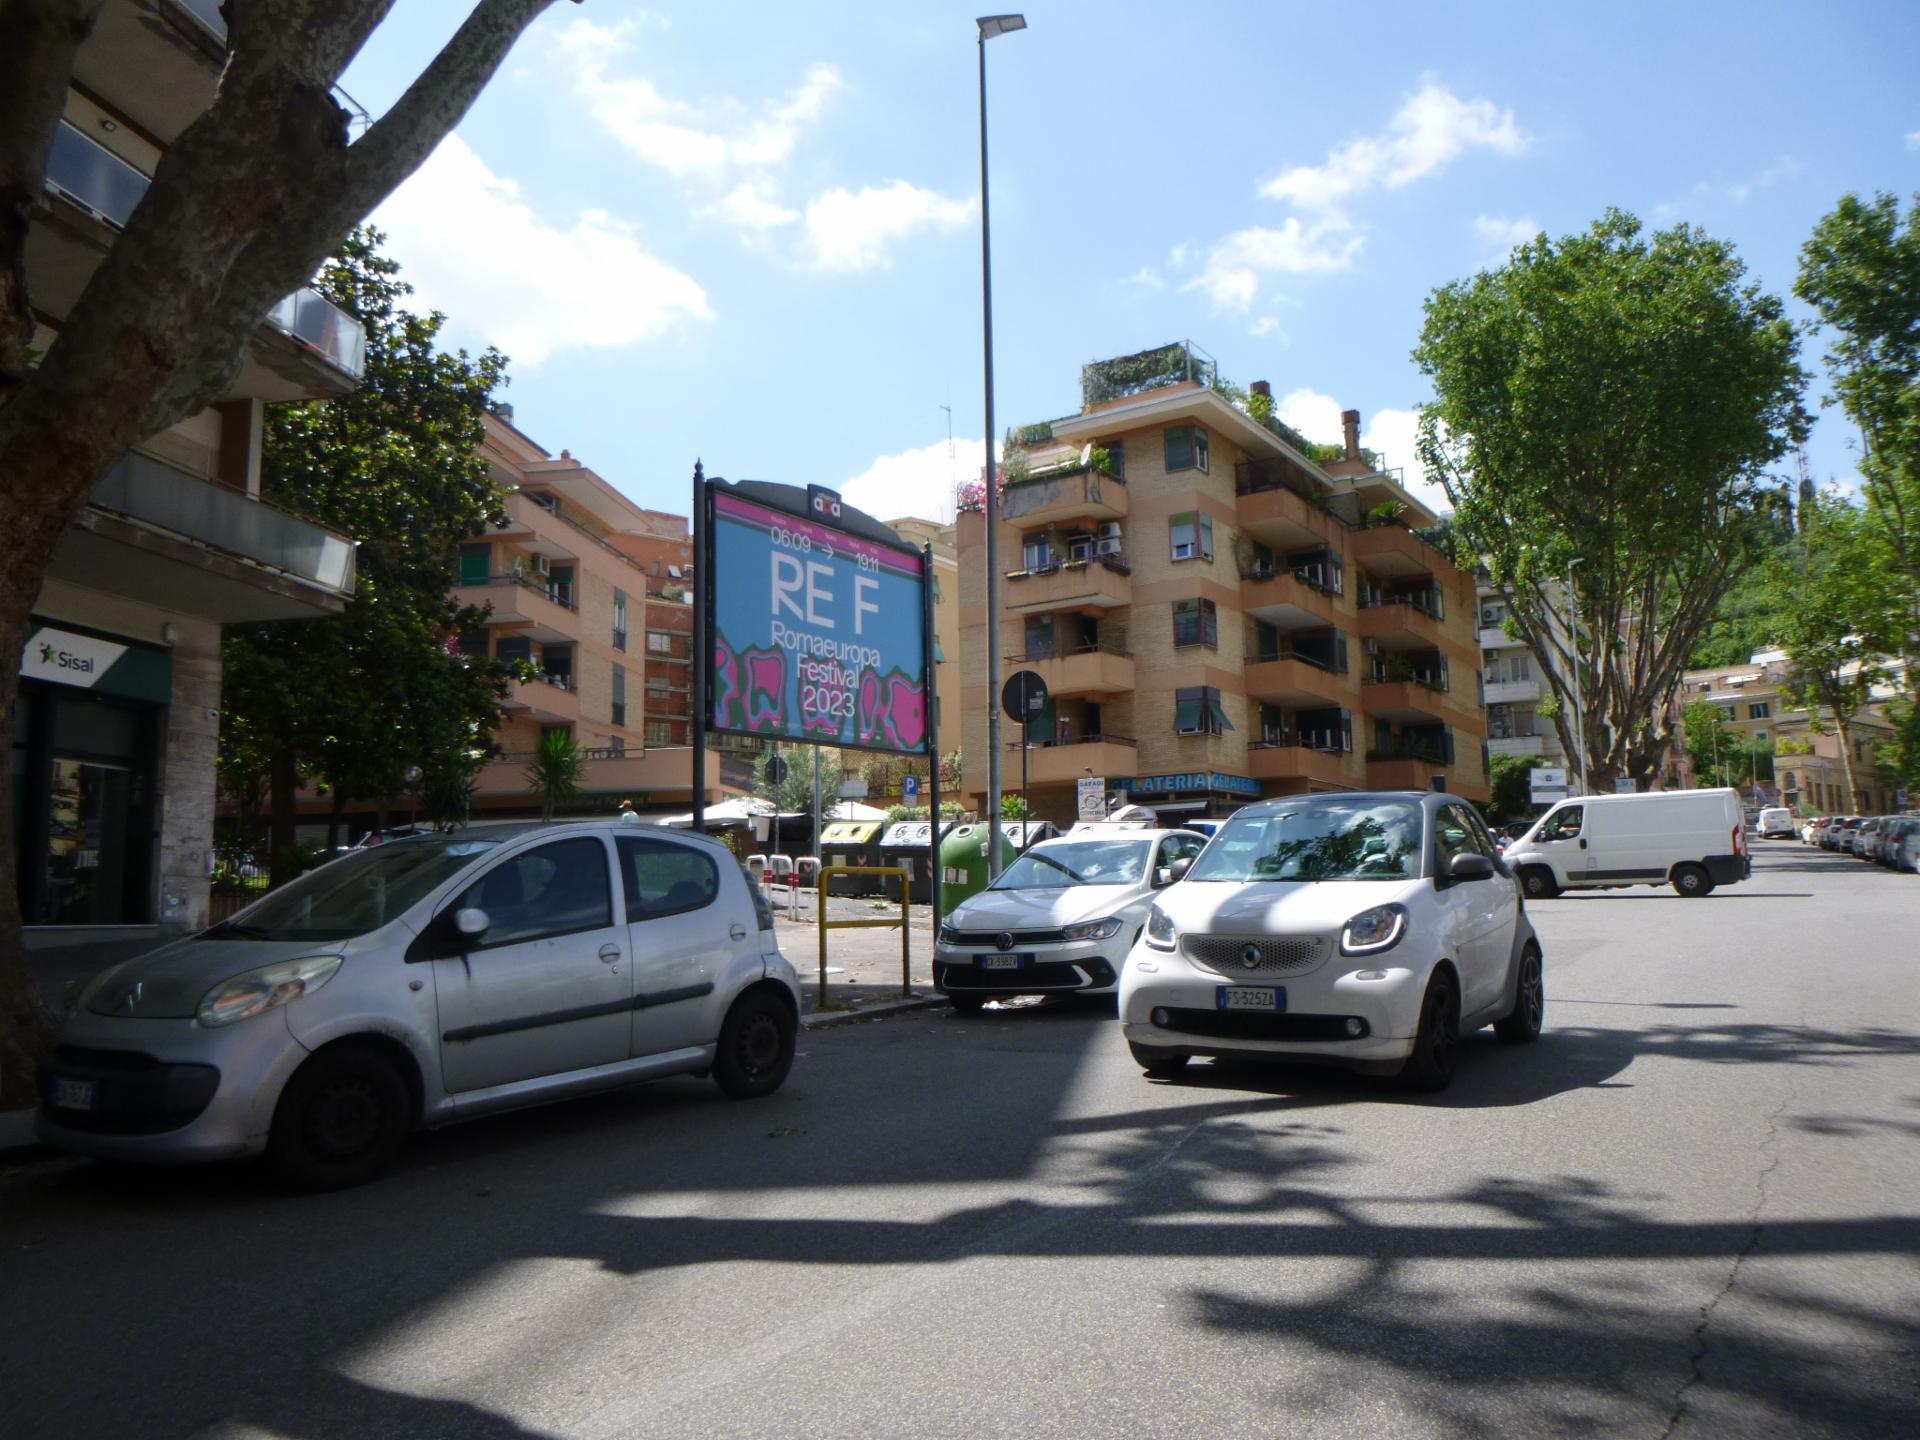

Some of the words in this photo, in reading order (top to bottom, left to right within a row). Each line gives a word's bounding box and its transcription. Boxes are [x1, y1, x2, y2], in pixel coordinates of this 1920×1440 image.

[771, 526, 811, 553] 06.09
[855, 552, 879, 575] 19.11
[771, 620, 880, 670] Romaeuropa
[58, 651, 94, 673] Sisal
[797, 653, 859, 689] Festival
[803, 686, 855, 717] 2023
[906, 777, 915, 793] P
[1111, 773, 1206, 793] GELATERIA
